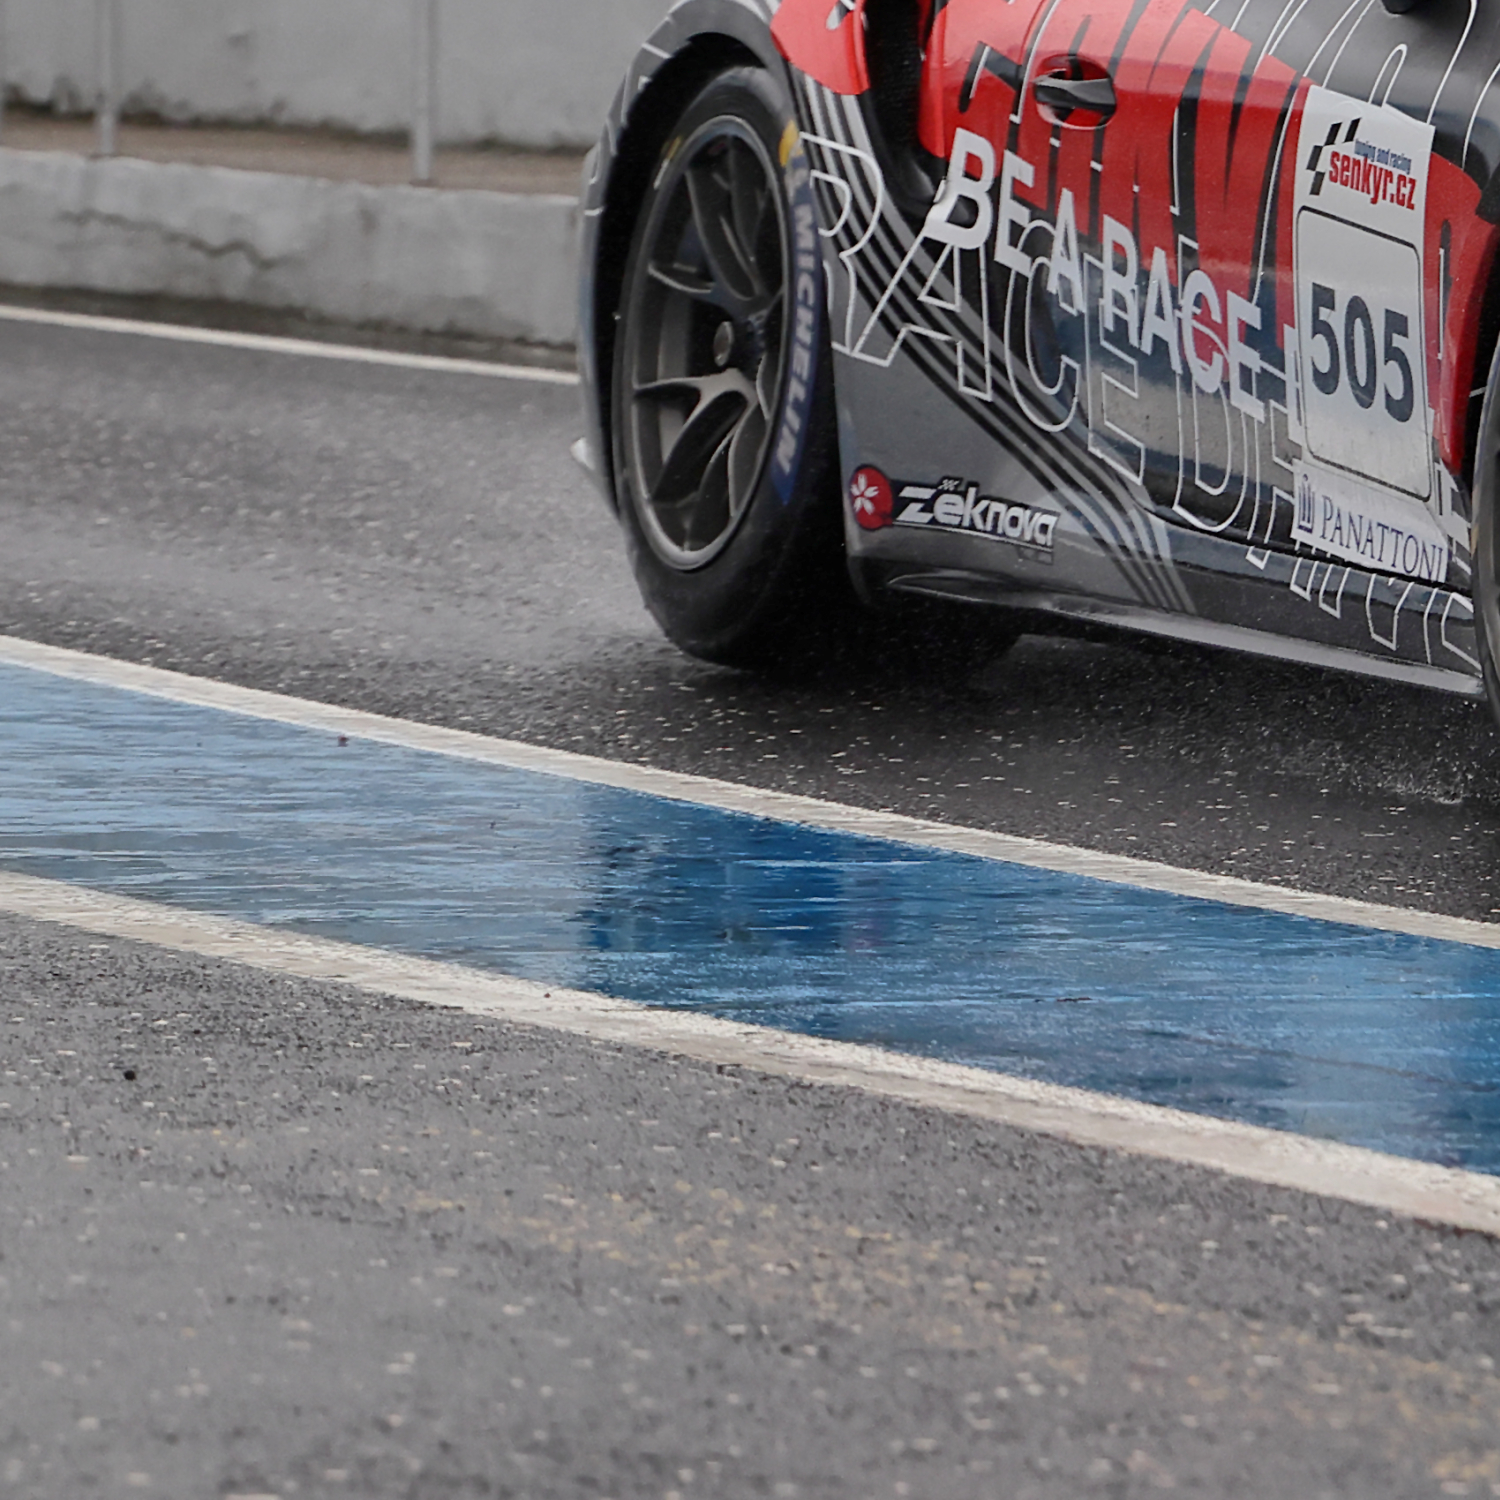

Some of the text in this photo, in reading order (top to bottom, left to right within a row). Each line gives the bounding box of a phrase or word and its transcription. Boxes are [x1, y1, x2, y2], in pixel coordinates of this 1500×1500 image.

[1328, 150, 1417, 211] senkyr.cz
[776, 202, 818, 476] MICHELIN
[926, 126, 1036, 278] BE
[1046, 187, 1084, 316] A
[1102, 213, 1266, 424] RACE
[1310, 281, 1415, 423] 505
[1319, 495, 1446, 583] PANATTONI
